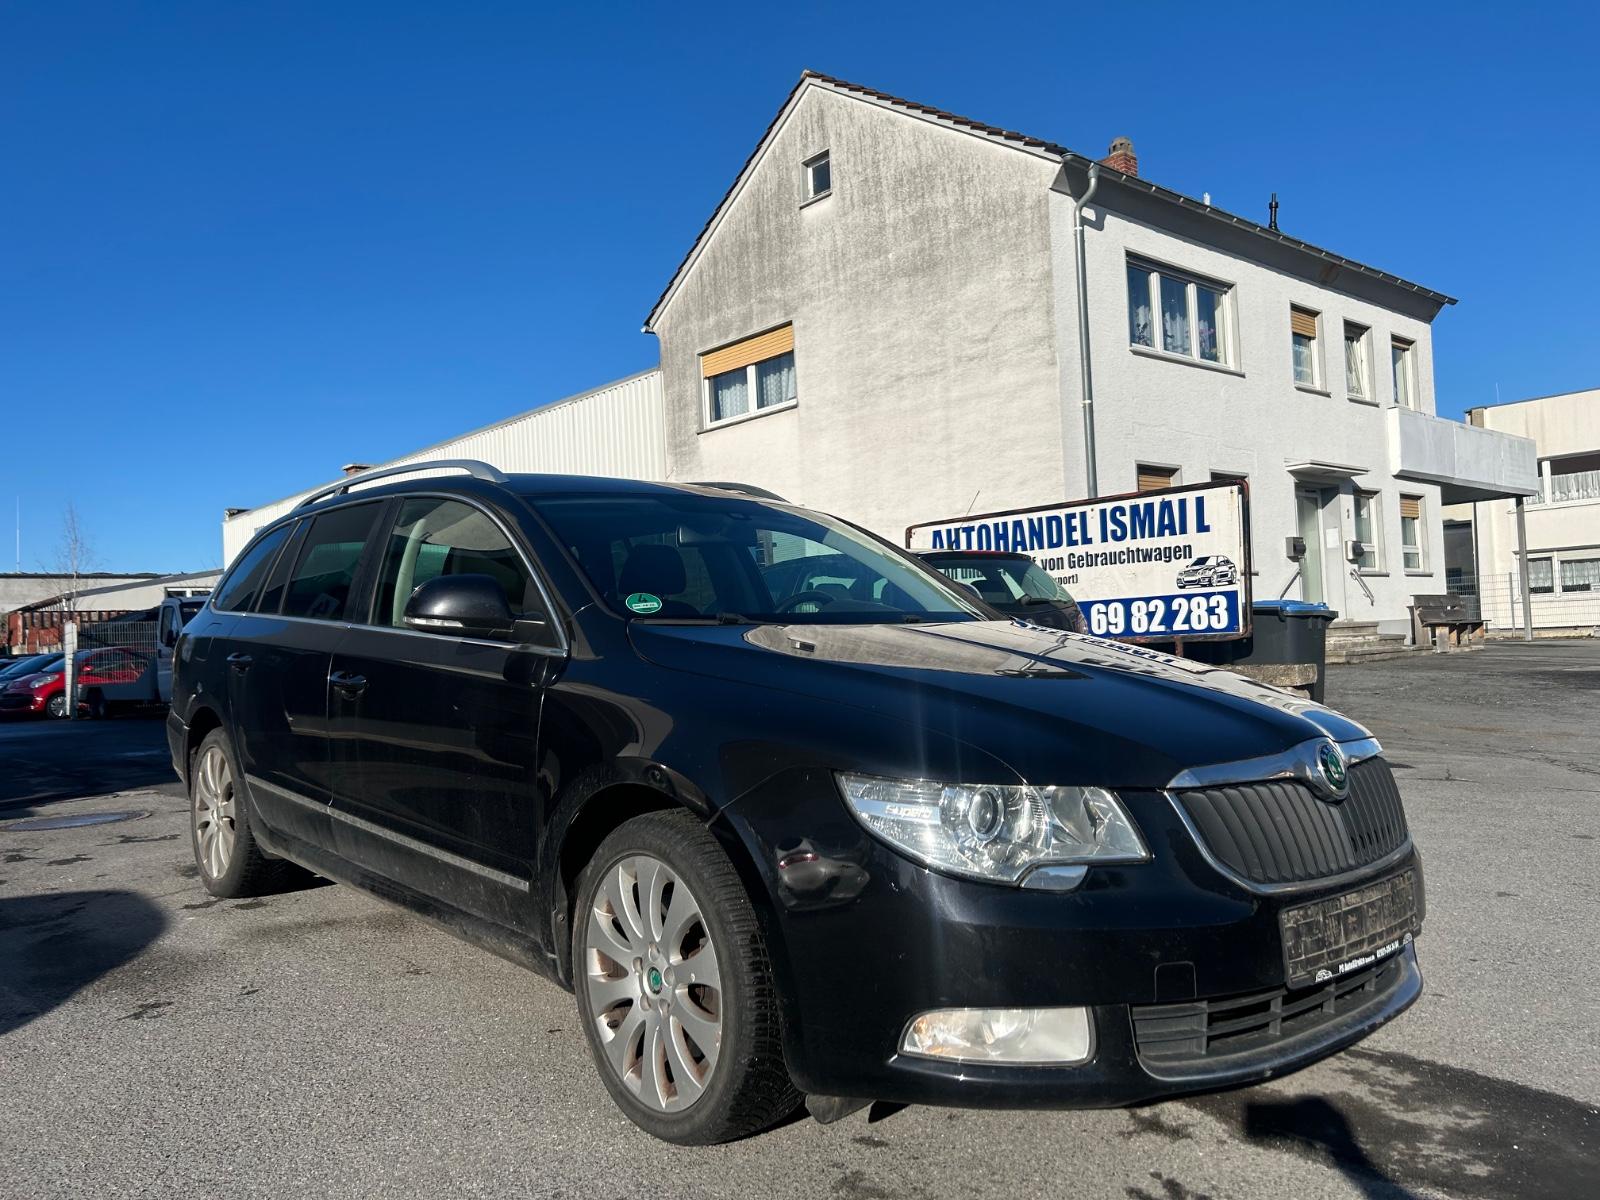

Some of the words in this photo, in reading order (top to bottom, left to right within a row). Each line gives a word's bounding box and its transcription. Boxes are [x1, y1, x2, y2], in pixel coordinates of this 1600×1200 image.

[932, 510, 1092, 553] AUTOHANDEL
[1041, 556, 1065, 571] von
[1068, 543, 1193, 570] Gebrauchtwagen
[1090, 601, 1125, 635] 69
[1131, 598, 1167, 634] 82
[1171, 594, 1229, 631] 283
